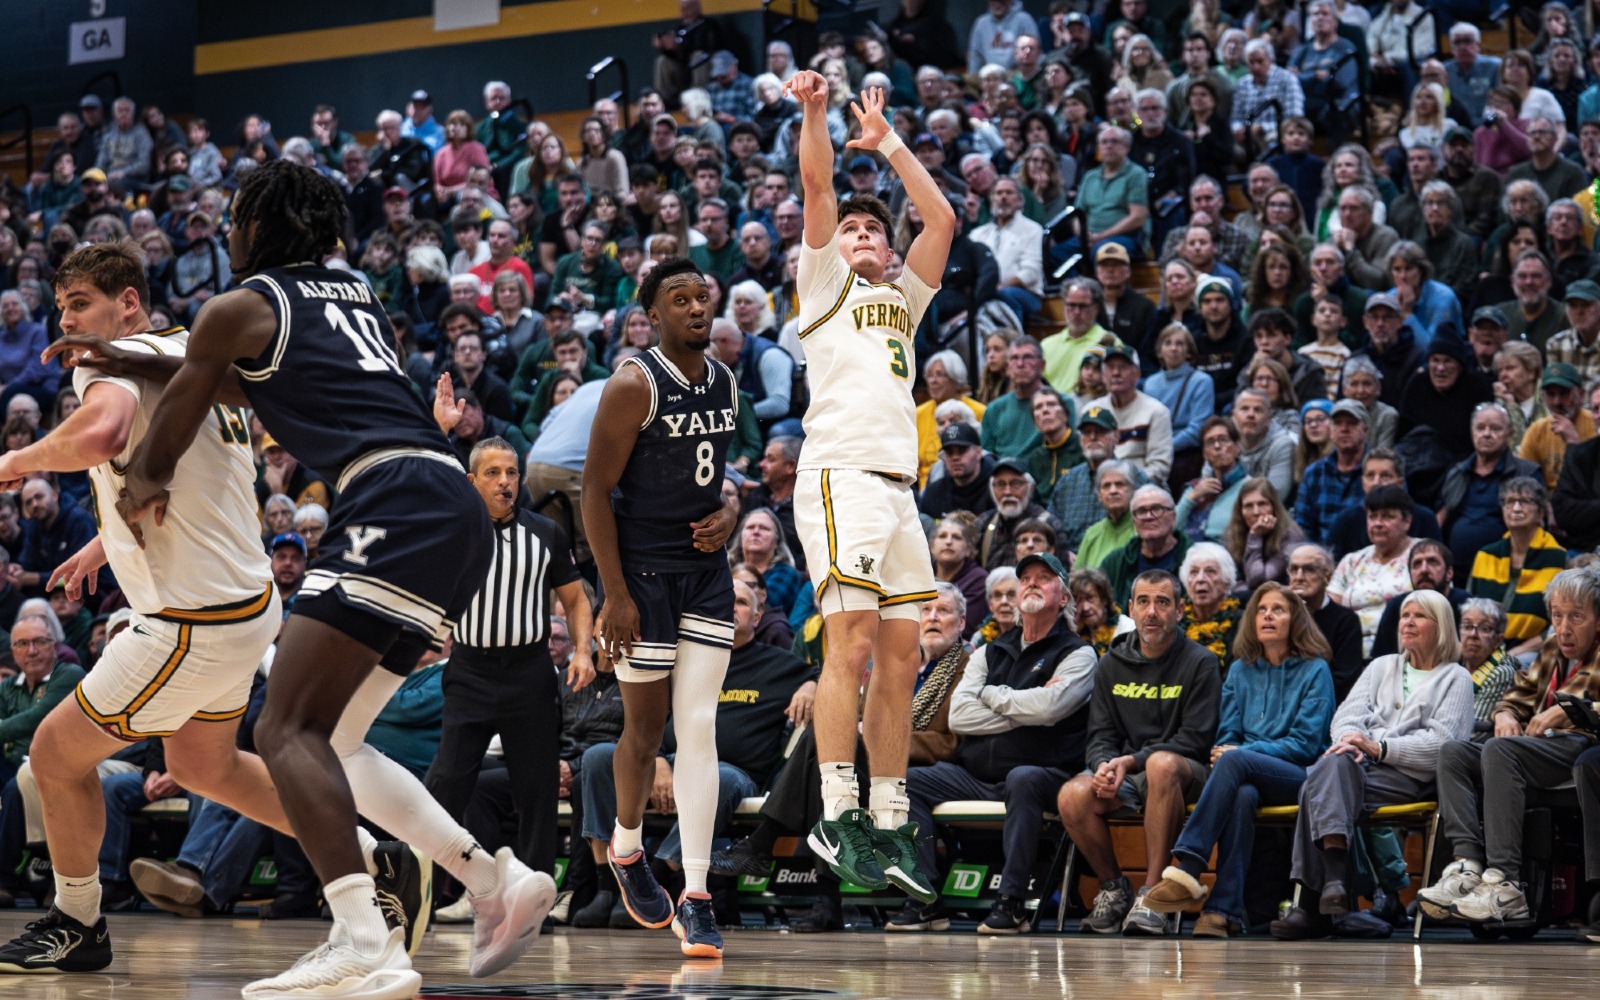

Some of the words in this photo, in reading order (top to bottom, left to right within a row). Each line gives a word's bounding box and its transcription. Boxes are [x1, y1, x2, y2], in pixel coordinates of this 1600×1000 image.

[83, 28, 112, 51] GA
[297, 281, 371, 304] ALETAN
[851, 303, 914, 341] VERMON
[324, 302, 404, 376] 10
[886, 337, 909, 380] 3
[661, 408, 736, 437] YALE
[695, 441, 715, 486] 8
[343, 525, 387, 566] Y
[718, 689, 760, 704] MONT
[776, 869, 818, 883] Bank
[953, 869, 982, 891] TD
